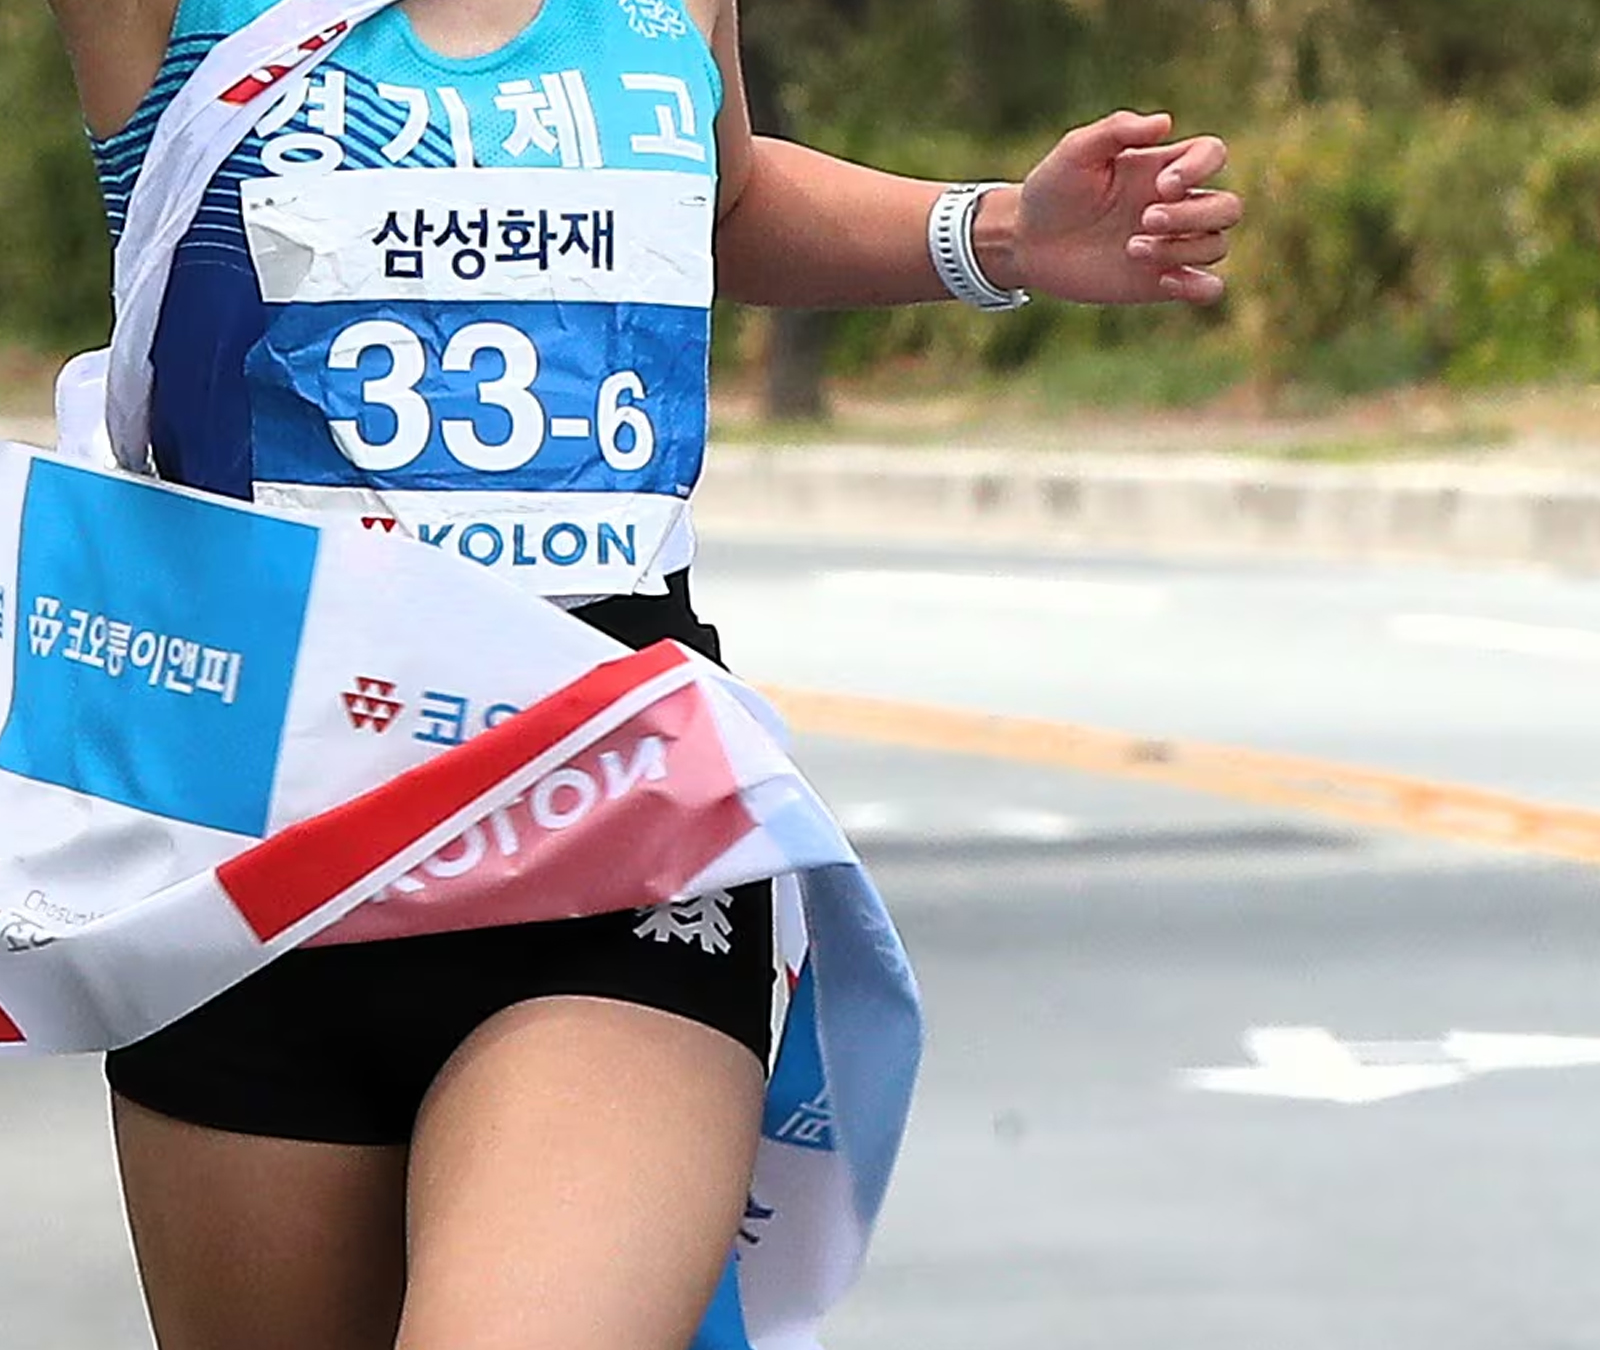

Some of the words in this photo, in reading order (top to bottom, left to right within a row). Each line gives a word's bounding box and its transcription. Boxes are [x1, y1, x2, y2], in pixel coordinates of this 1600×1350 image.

[253, 69, 705, 179] 경기체고
[371, 209, 617, 280] 삼성화재
[326, 318, 656, 473] 33-6
[62, 608, 244, 705] 코오롱이앤피
